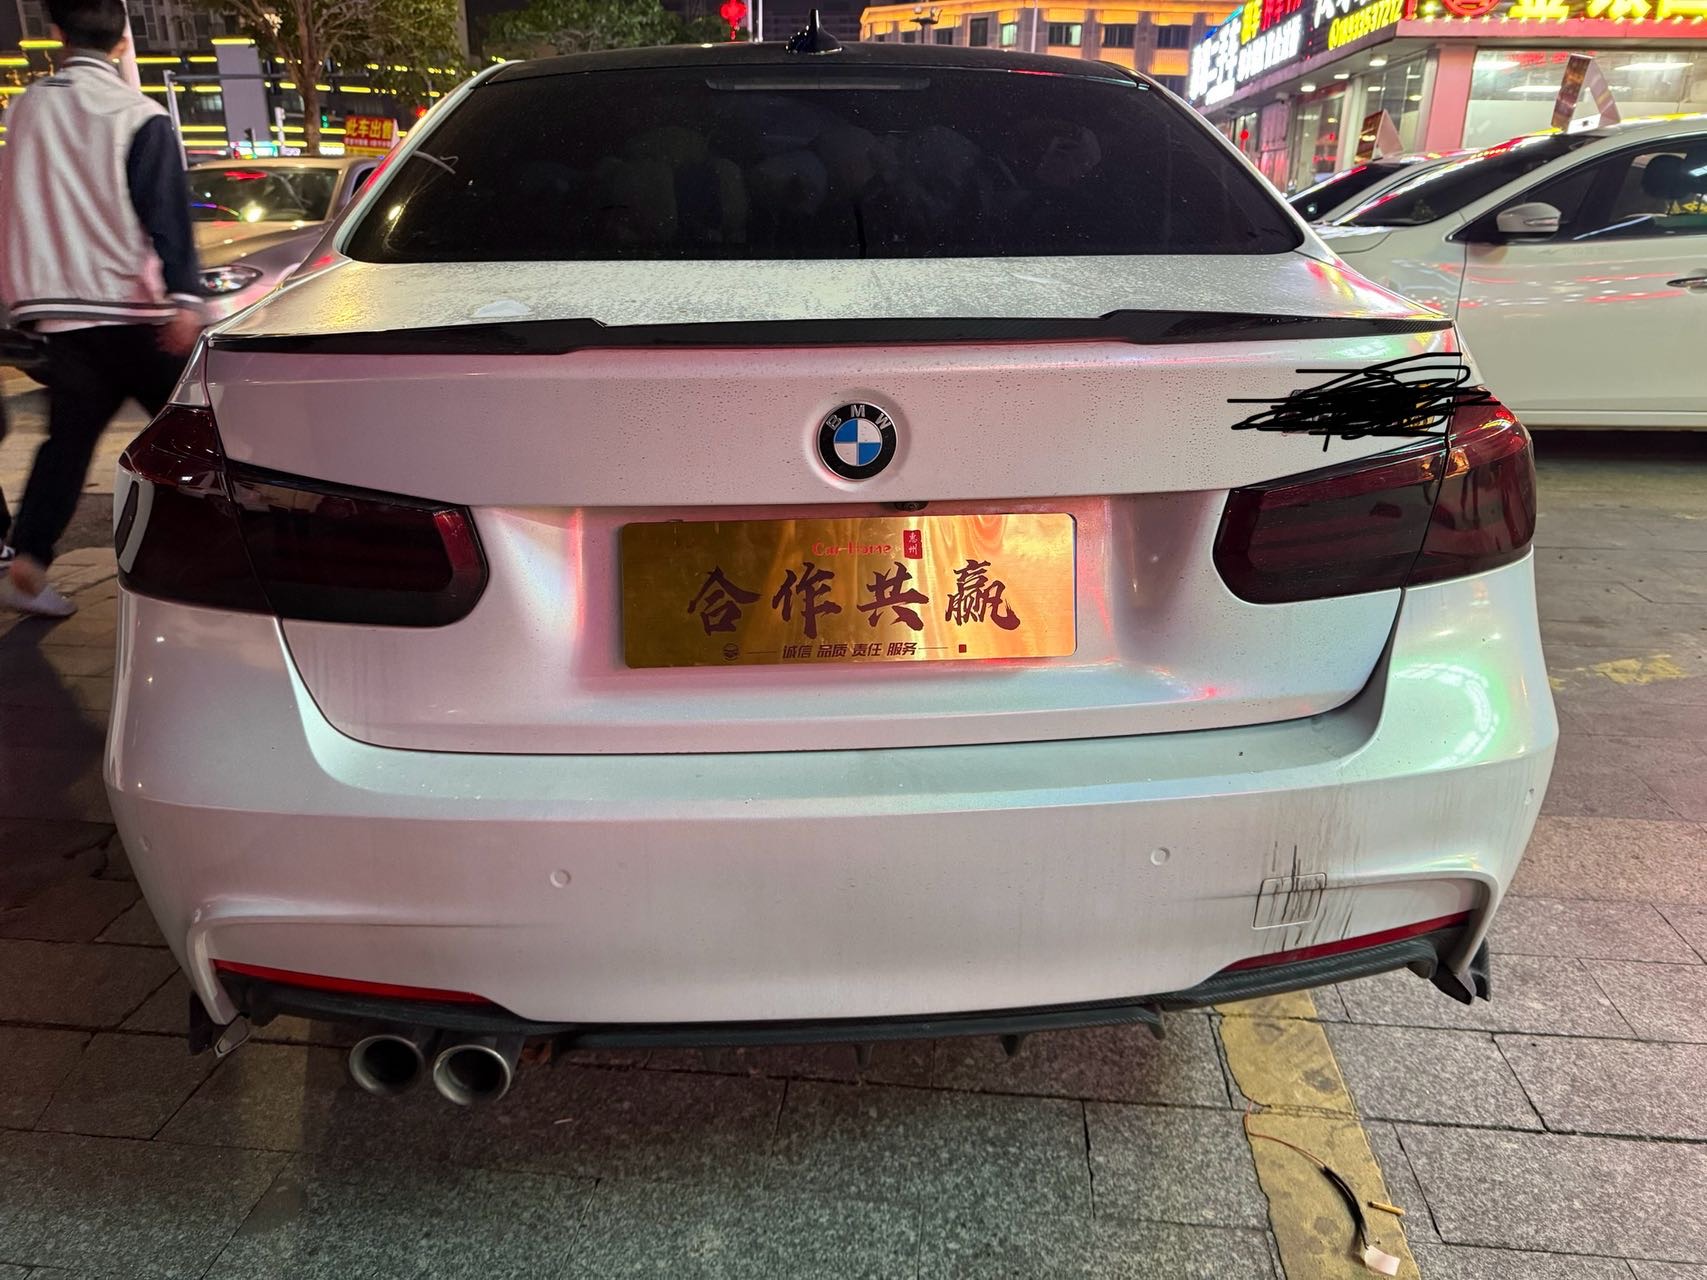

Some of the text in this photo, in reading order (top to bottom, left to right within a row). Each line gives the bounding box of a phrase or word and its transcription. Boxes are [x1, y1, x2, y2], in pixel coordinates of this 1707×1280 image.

[825, 404, 892, 431] BMW
[687, 558, 1021, 640] 合作共赢
[782, 641, 917, 659] 诚信 品质 责任 服务
